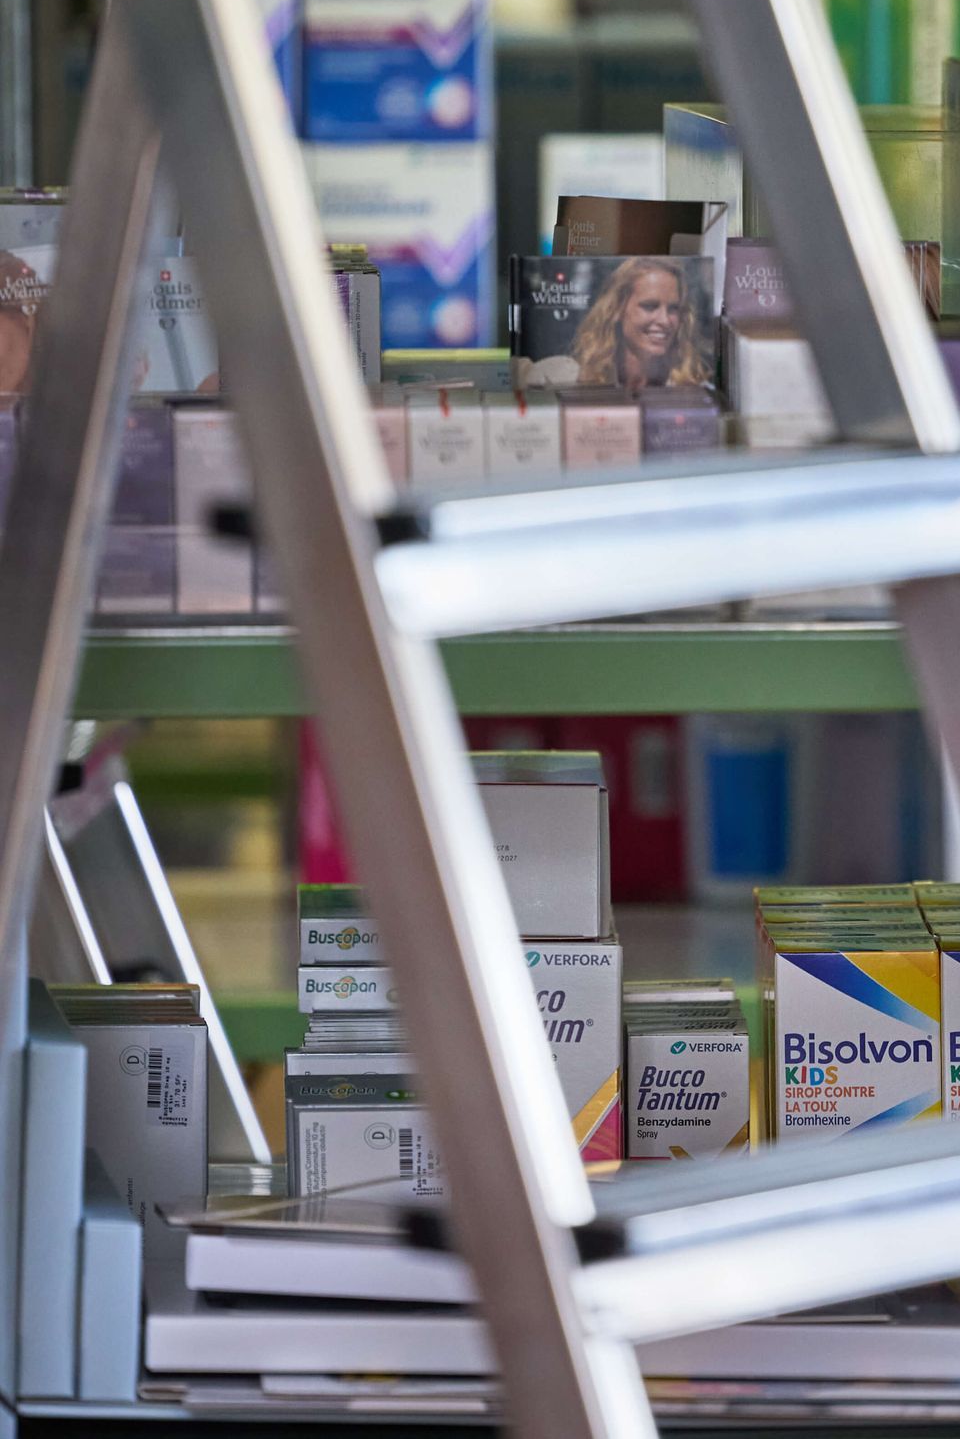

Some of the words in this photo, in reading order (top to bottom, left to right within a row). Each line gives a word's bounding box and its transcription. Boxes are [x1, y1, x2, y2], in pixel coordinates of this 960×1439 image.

[540, 281, 581, 293] Louis
[532, 292, 591, 306] Widmer
[308, 927, 379, 948] Buscopan
[543, 954, 608, 967] VERFORA
[305, 977, 377, 998] Buscopan
[688, 1042, 741, 1053] VERFORA
[784, 1032, 933, 1064] Bisolvon
[639, 1066, 705, 1088] Bucco
[785, 1065, 838, 1086] KIDS
[785, 1086, 822, 1099] SIROP
[824, 1086, 875, 1098] CONTRE
[785, 1101, 801, 1113] LA
[801, 1100, 838, 1113] TOUX
[637, 1116, 711, 1128] Benzydamine
[785, 1114, 851, 1127] Bromhexine
[636, 1129, 658, 1140] Spray
